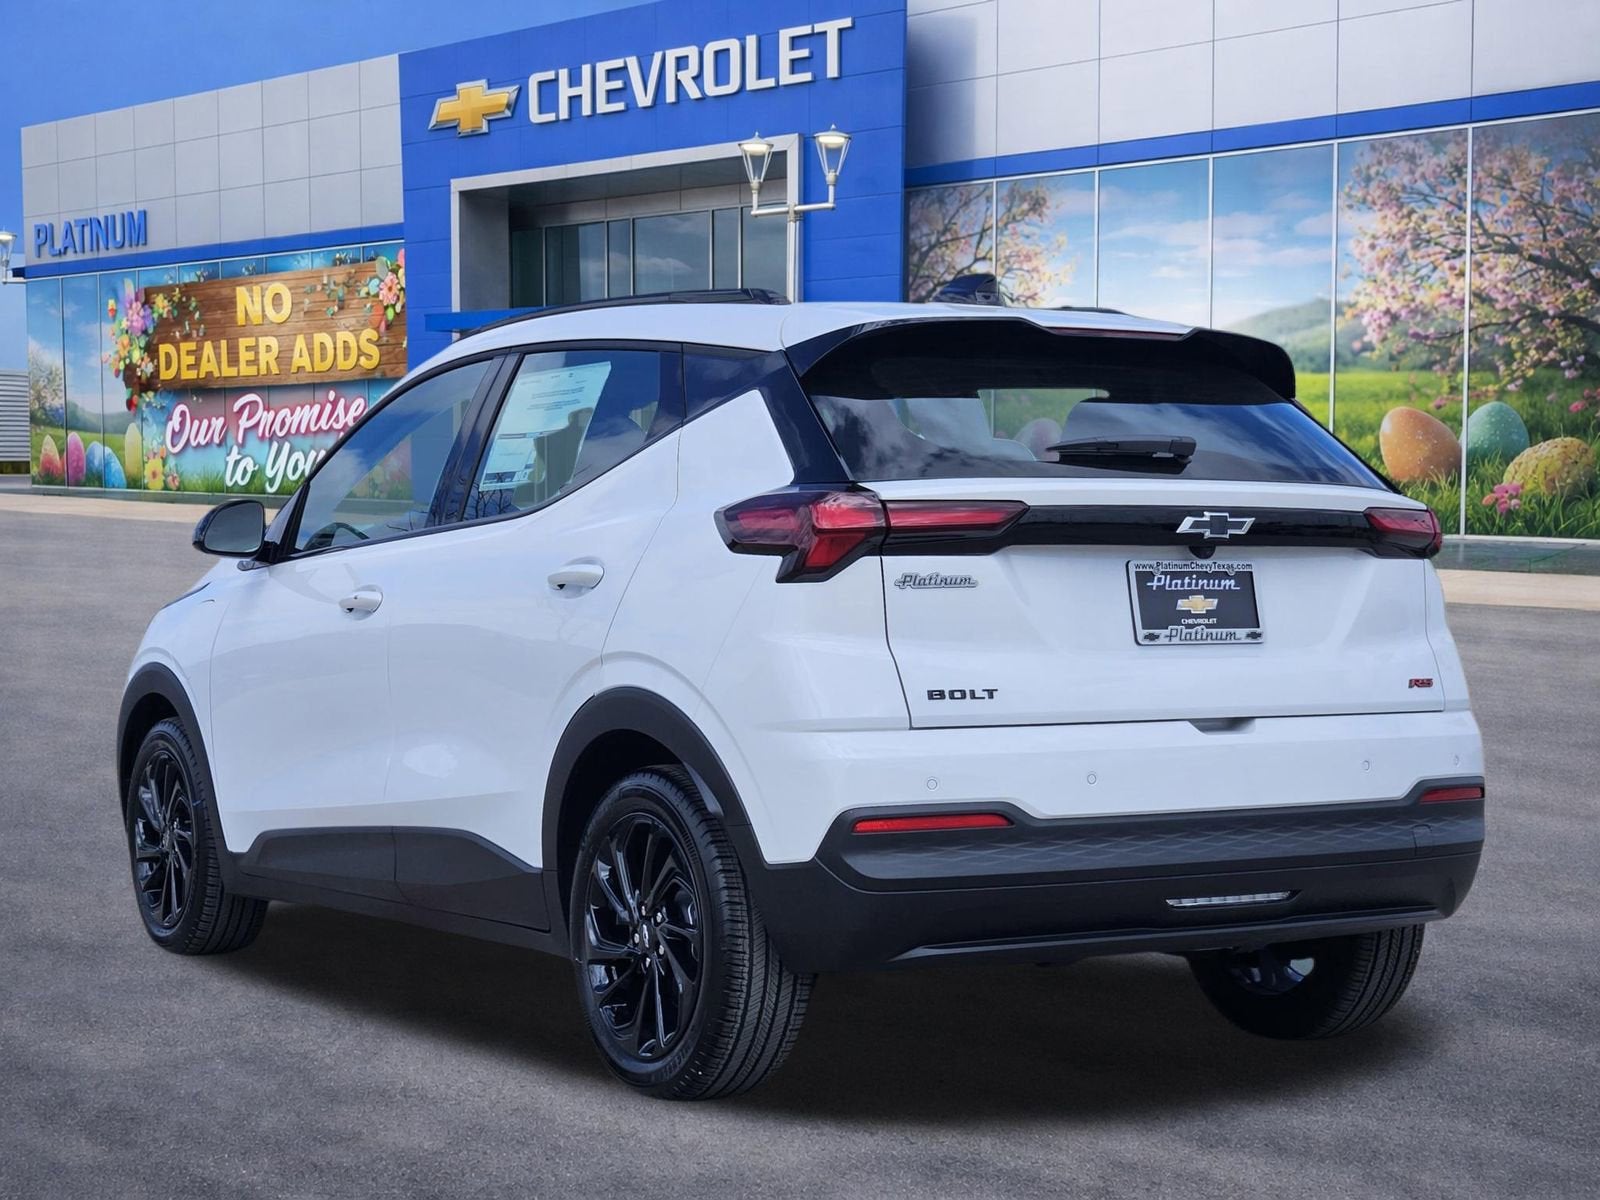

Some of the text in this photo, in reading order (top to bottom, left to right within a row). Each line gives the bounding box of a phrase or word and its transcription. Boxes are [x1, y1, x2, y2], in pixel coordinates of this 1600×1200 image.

[528, 17, 854, 124] CHEVROLET
[34, 209, 148, 258] PLATINUM
[236, 282, 293, 326] NO
[159, 328, 381, 381] DEALER ADDS
[166, 390, 368, 455] Our Promise
[225, 445, 259, 487] to
[894, 572, 979, 589] Platinum
[1134, 561, 1253, 573] www.PlatinumChevyTexas.com
[1146, 574, 1241, 591] Platinum
[1164, 627, 1242, 643] Platinum
[926, 689, 998, 700] BOLT
[1408, 678, 1434, 689] RS
